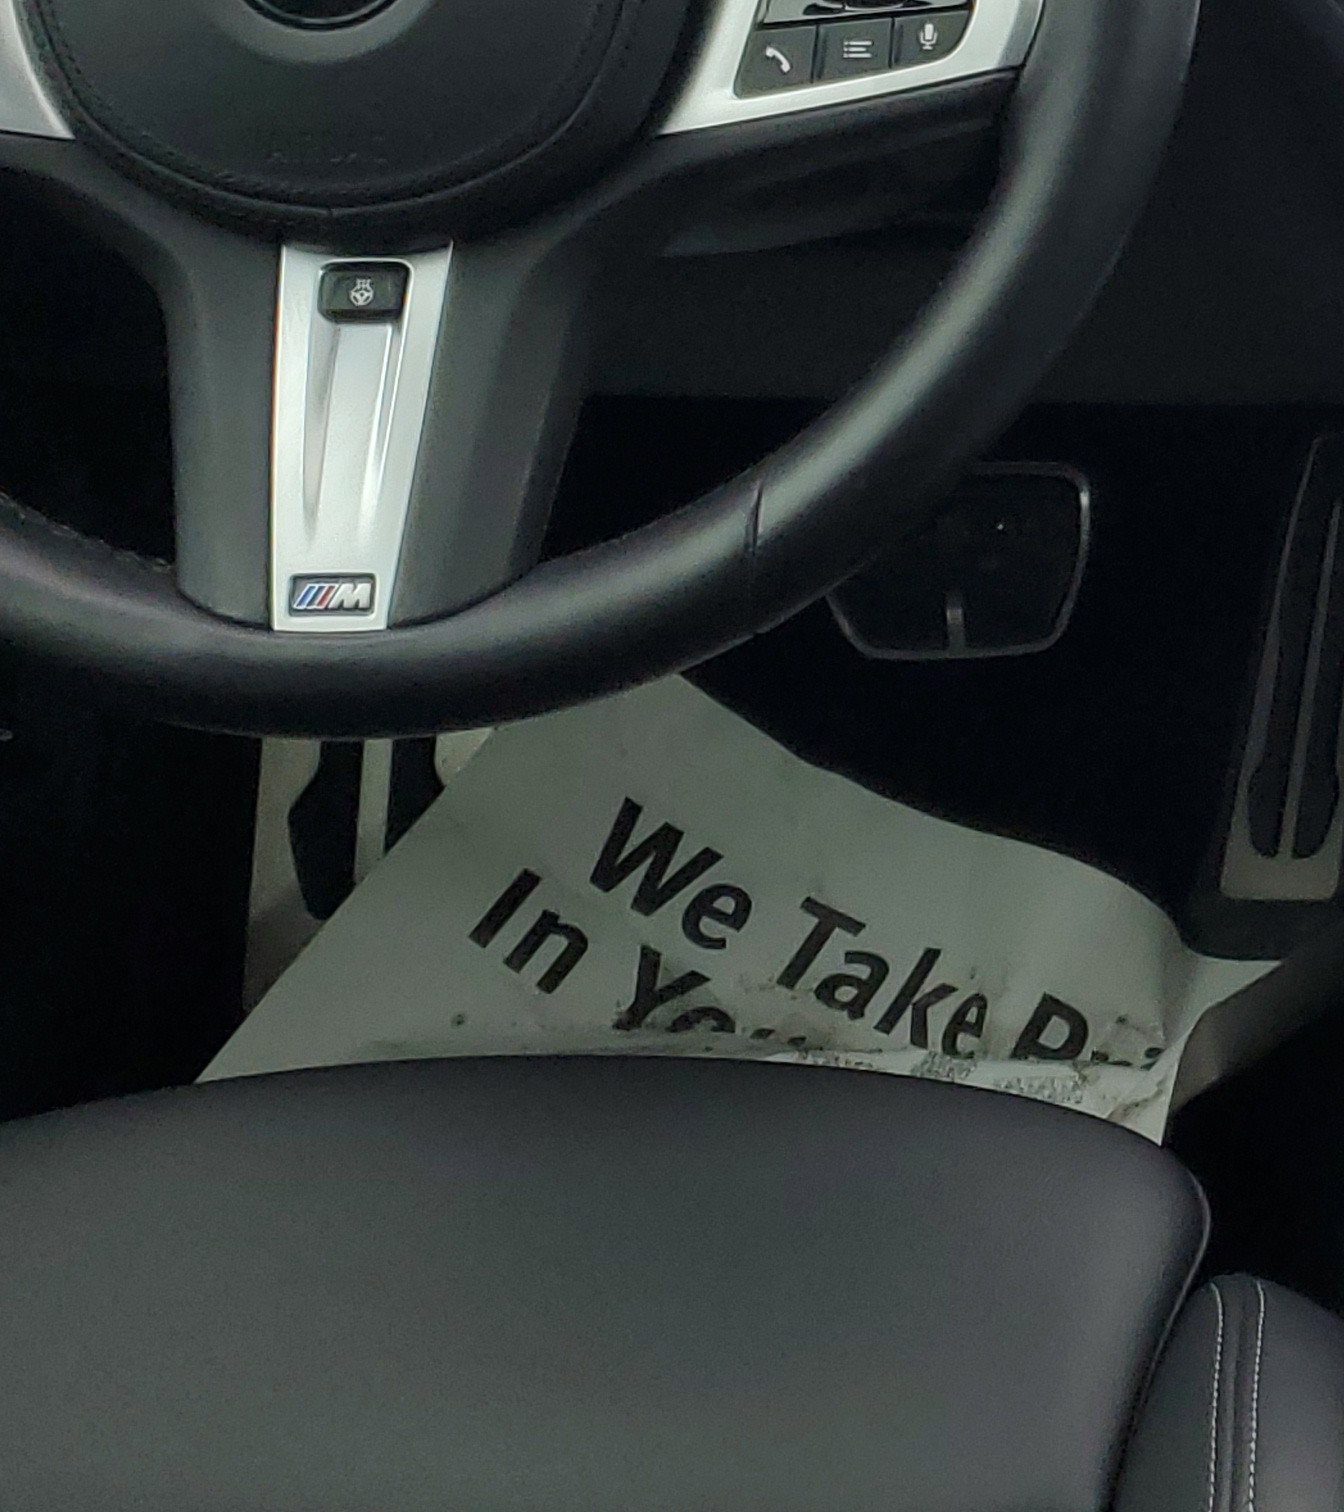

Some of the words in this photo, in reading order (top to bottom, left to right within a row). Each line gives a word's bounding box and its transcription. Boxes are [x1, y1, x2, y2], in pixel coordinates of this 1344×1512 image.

[467, 866, 590, 996] In
[589, 796, 753, 950] We
[775, 896, 989, 1059] Take
